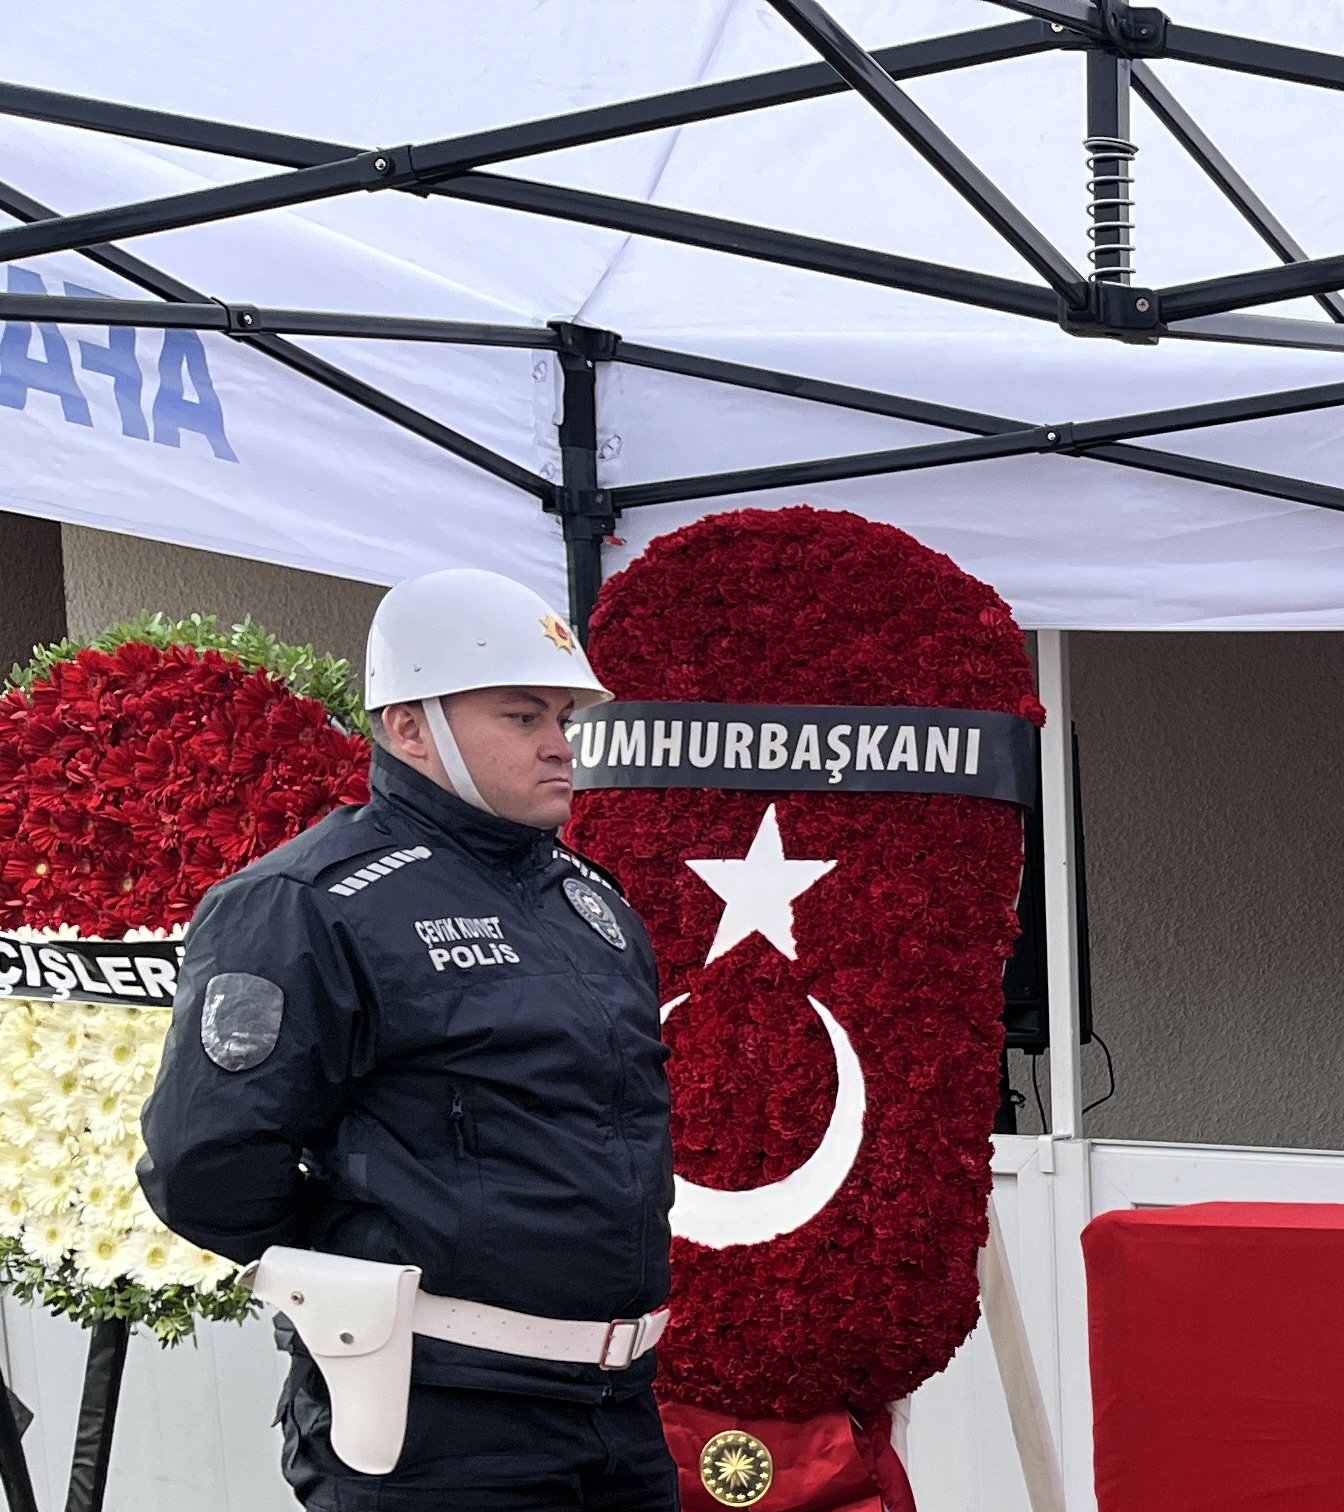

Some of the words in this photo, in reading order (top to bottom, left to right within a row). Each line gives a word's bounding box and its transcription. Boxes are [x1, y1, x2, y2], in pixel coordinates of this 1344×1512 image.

[415, 918, 461, 948] ÇEVİK
[454, 916, 504, 939] KUVVET
[428, 943, 520, 971] POLİS
